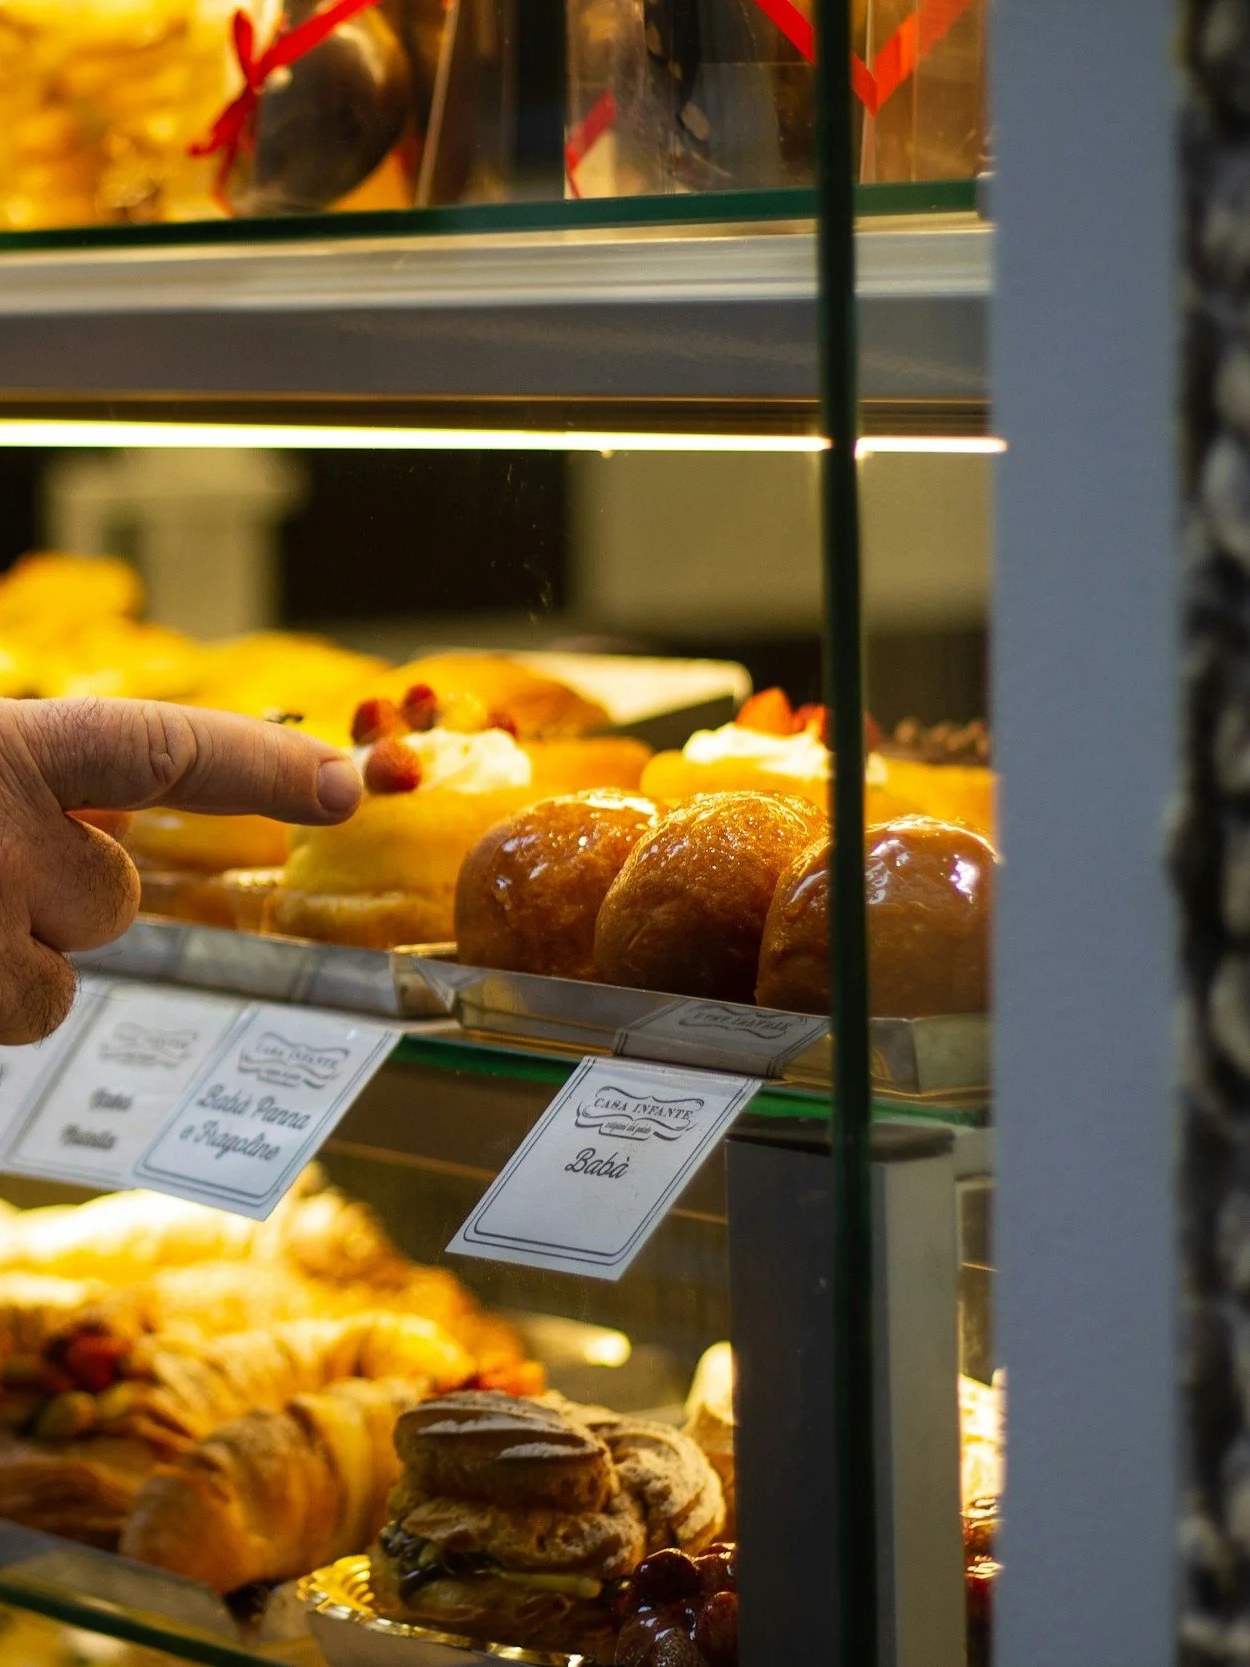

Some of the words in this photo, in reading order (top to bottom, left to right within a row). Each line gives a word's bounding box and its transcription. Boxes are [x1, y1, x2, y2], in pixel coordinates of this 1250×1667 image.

[251, 1095, 312, 1130] Panna
[594, 1098, 628, 1112] CASA
[632, 1103, 694, 1120] INFANTE
[179, 1125, 195, 1141] e
[564, 1147, 630, 1179] Babà
